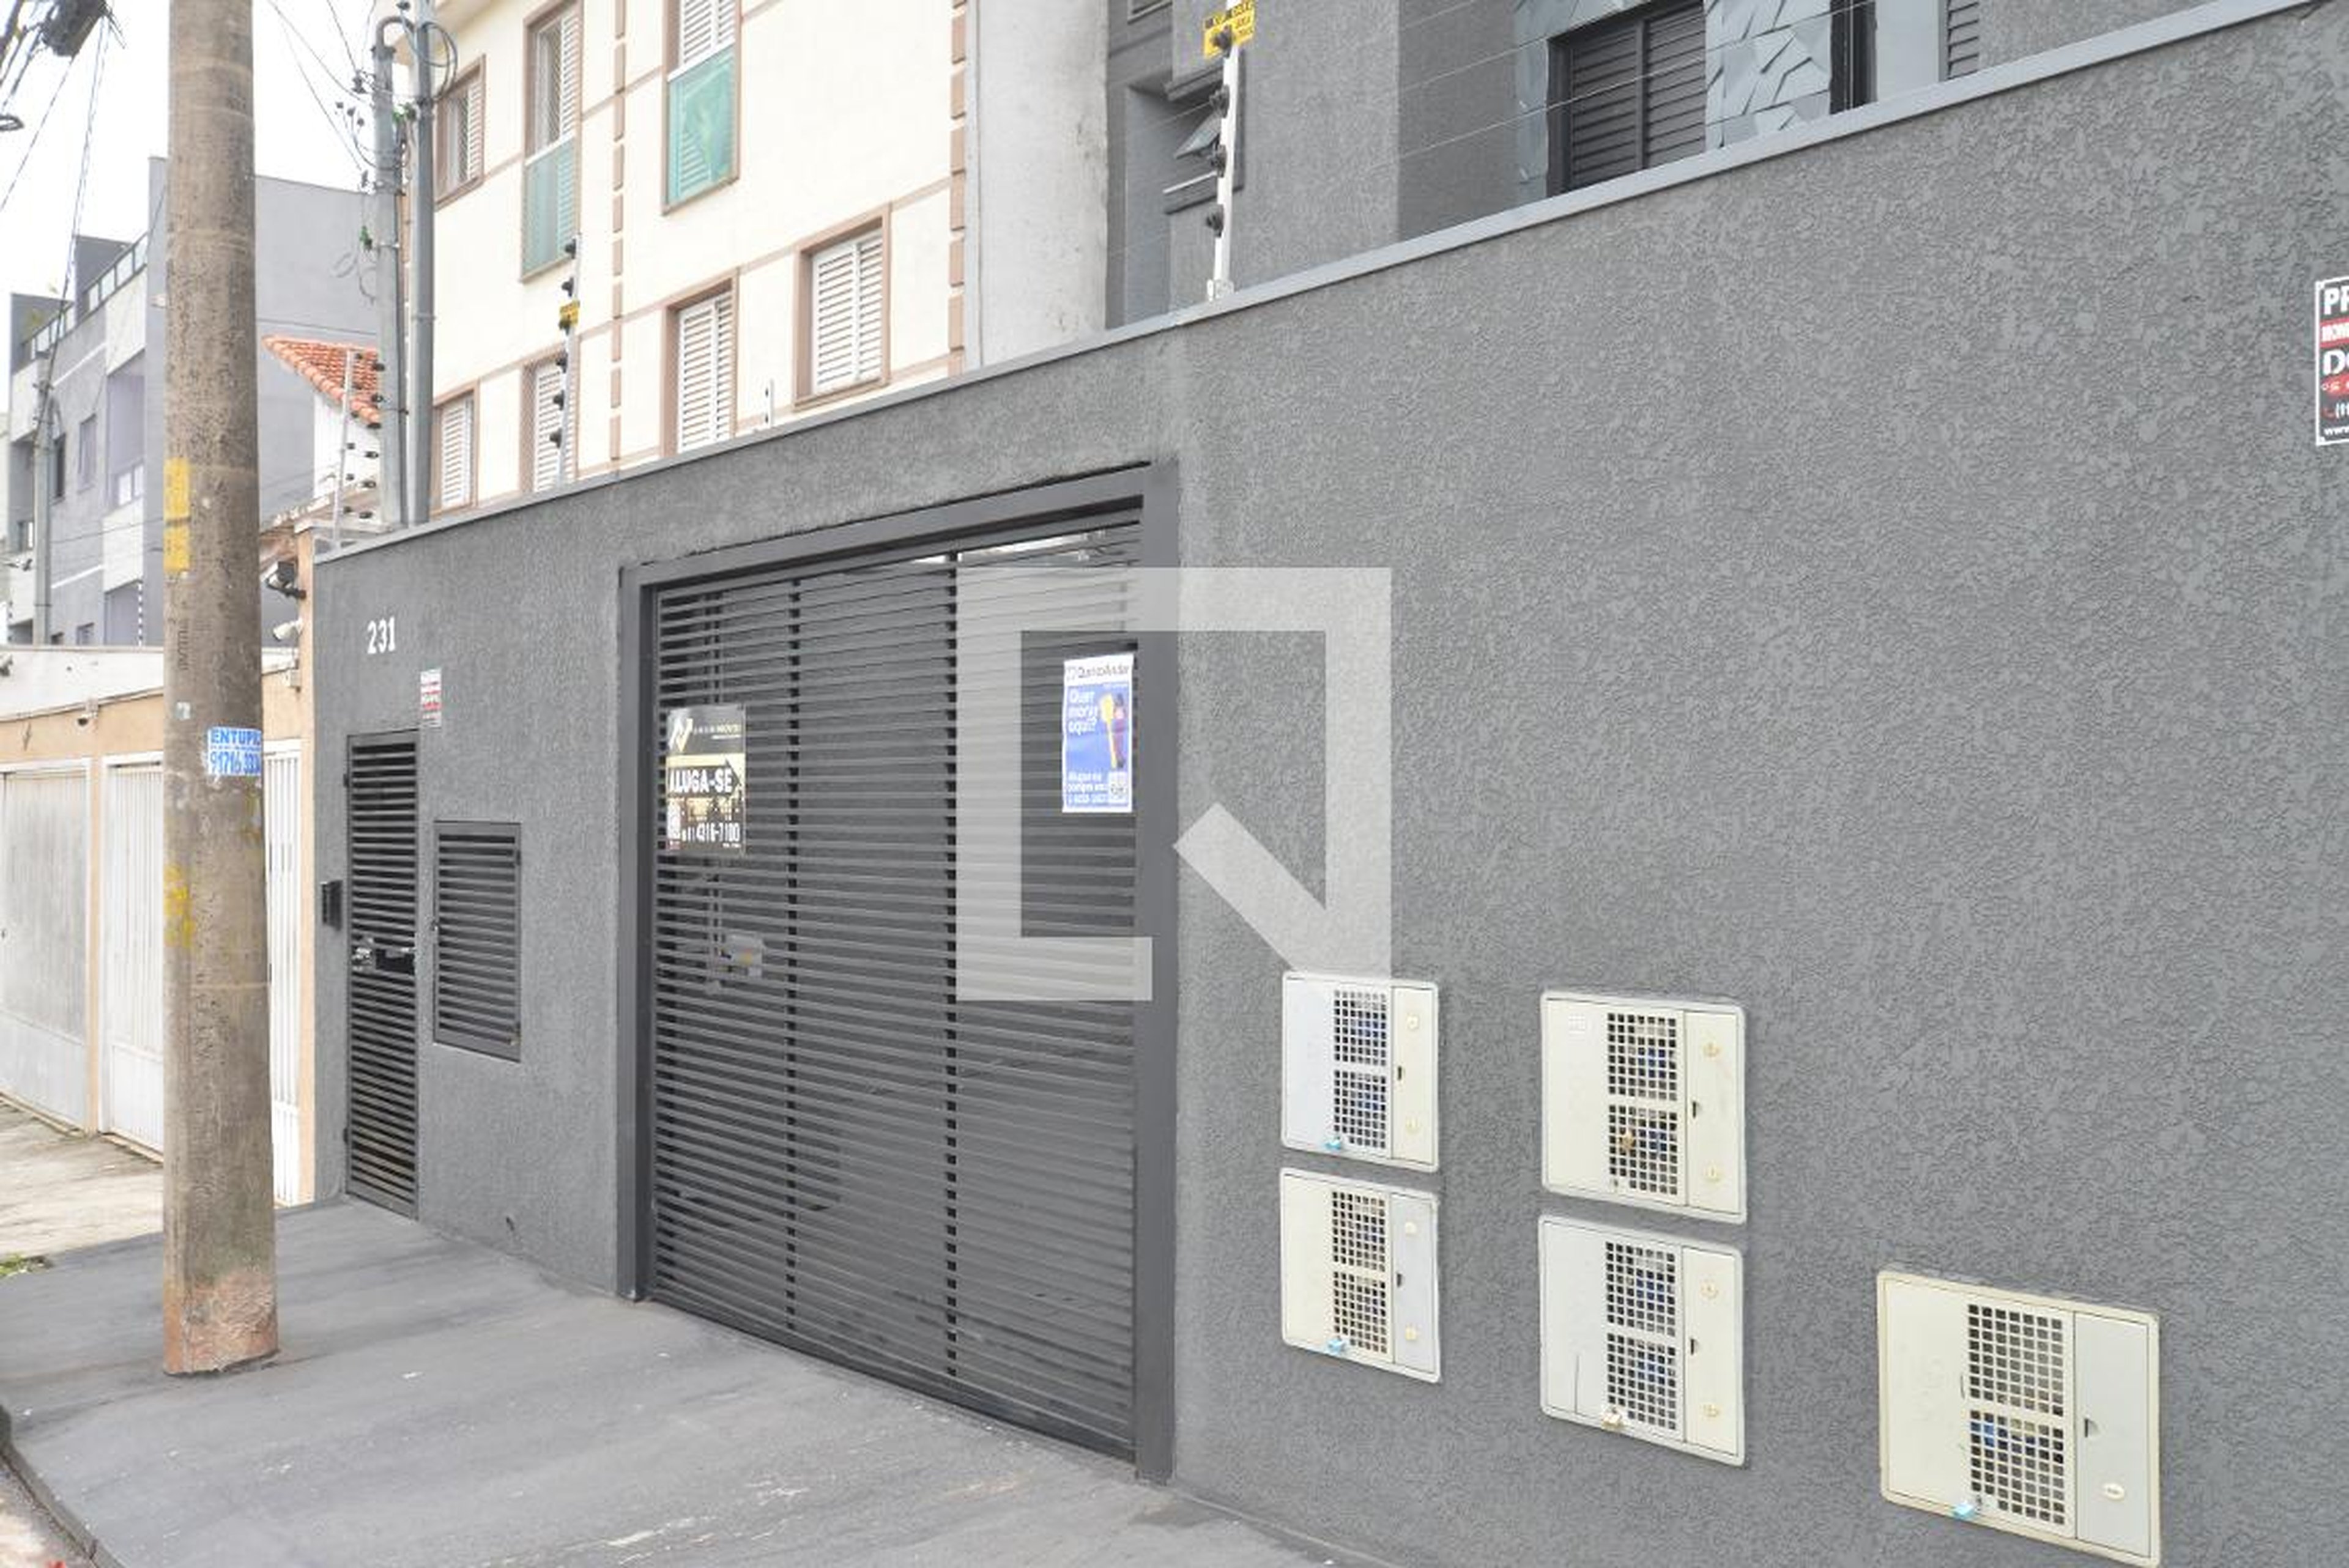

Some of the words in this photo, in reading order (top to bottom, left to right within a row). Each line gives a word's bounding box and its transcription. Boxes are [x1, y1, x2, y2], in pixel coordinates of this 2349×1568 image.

[2323, 350, 2349, 376] D
[367, 616, 396, 654] 231
[669, 768, 733, 793] ALUGA-SE
